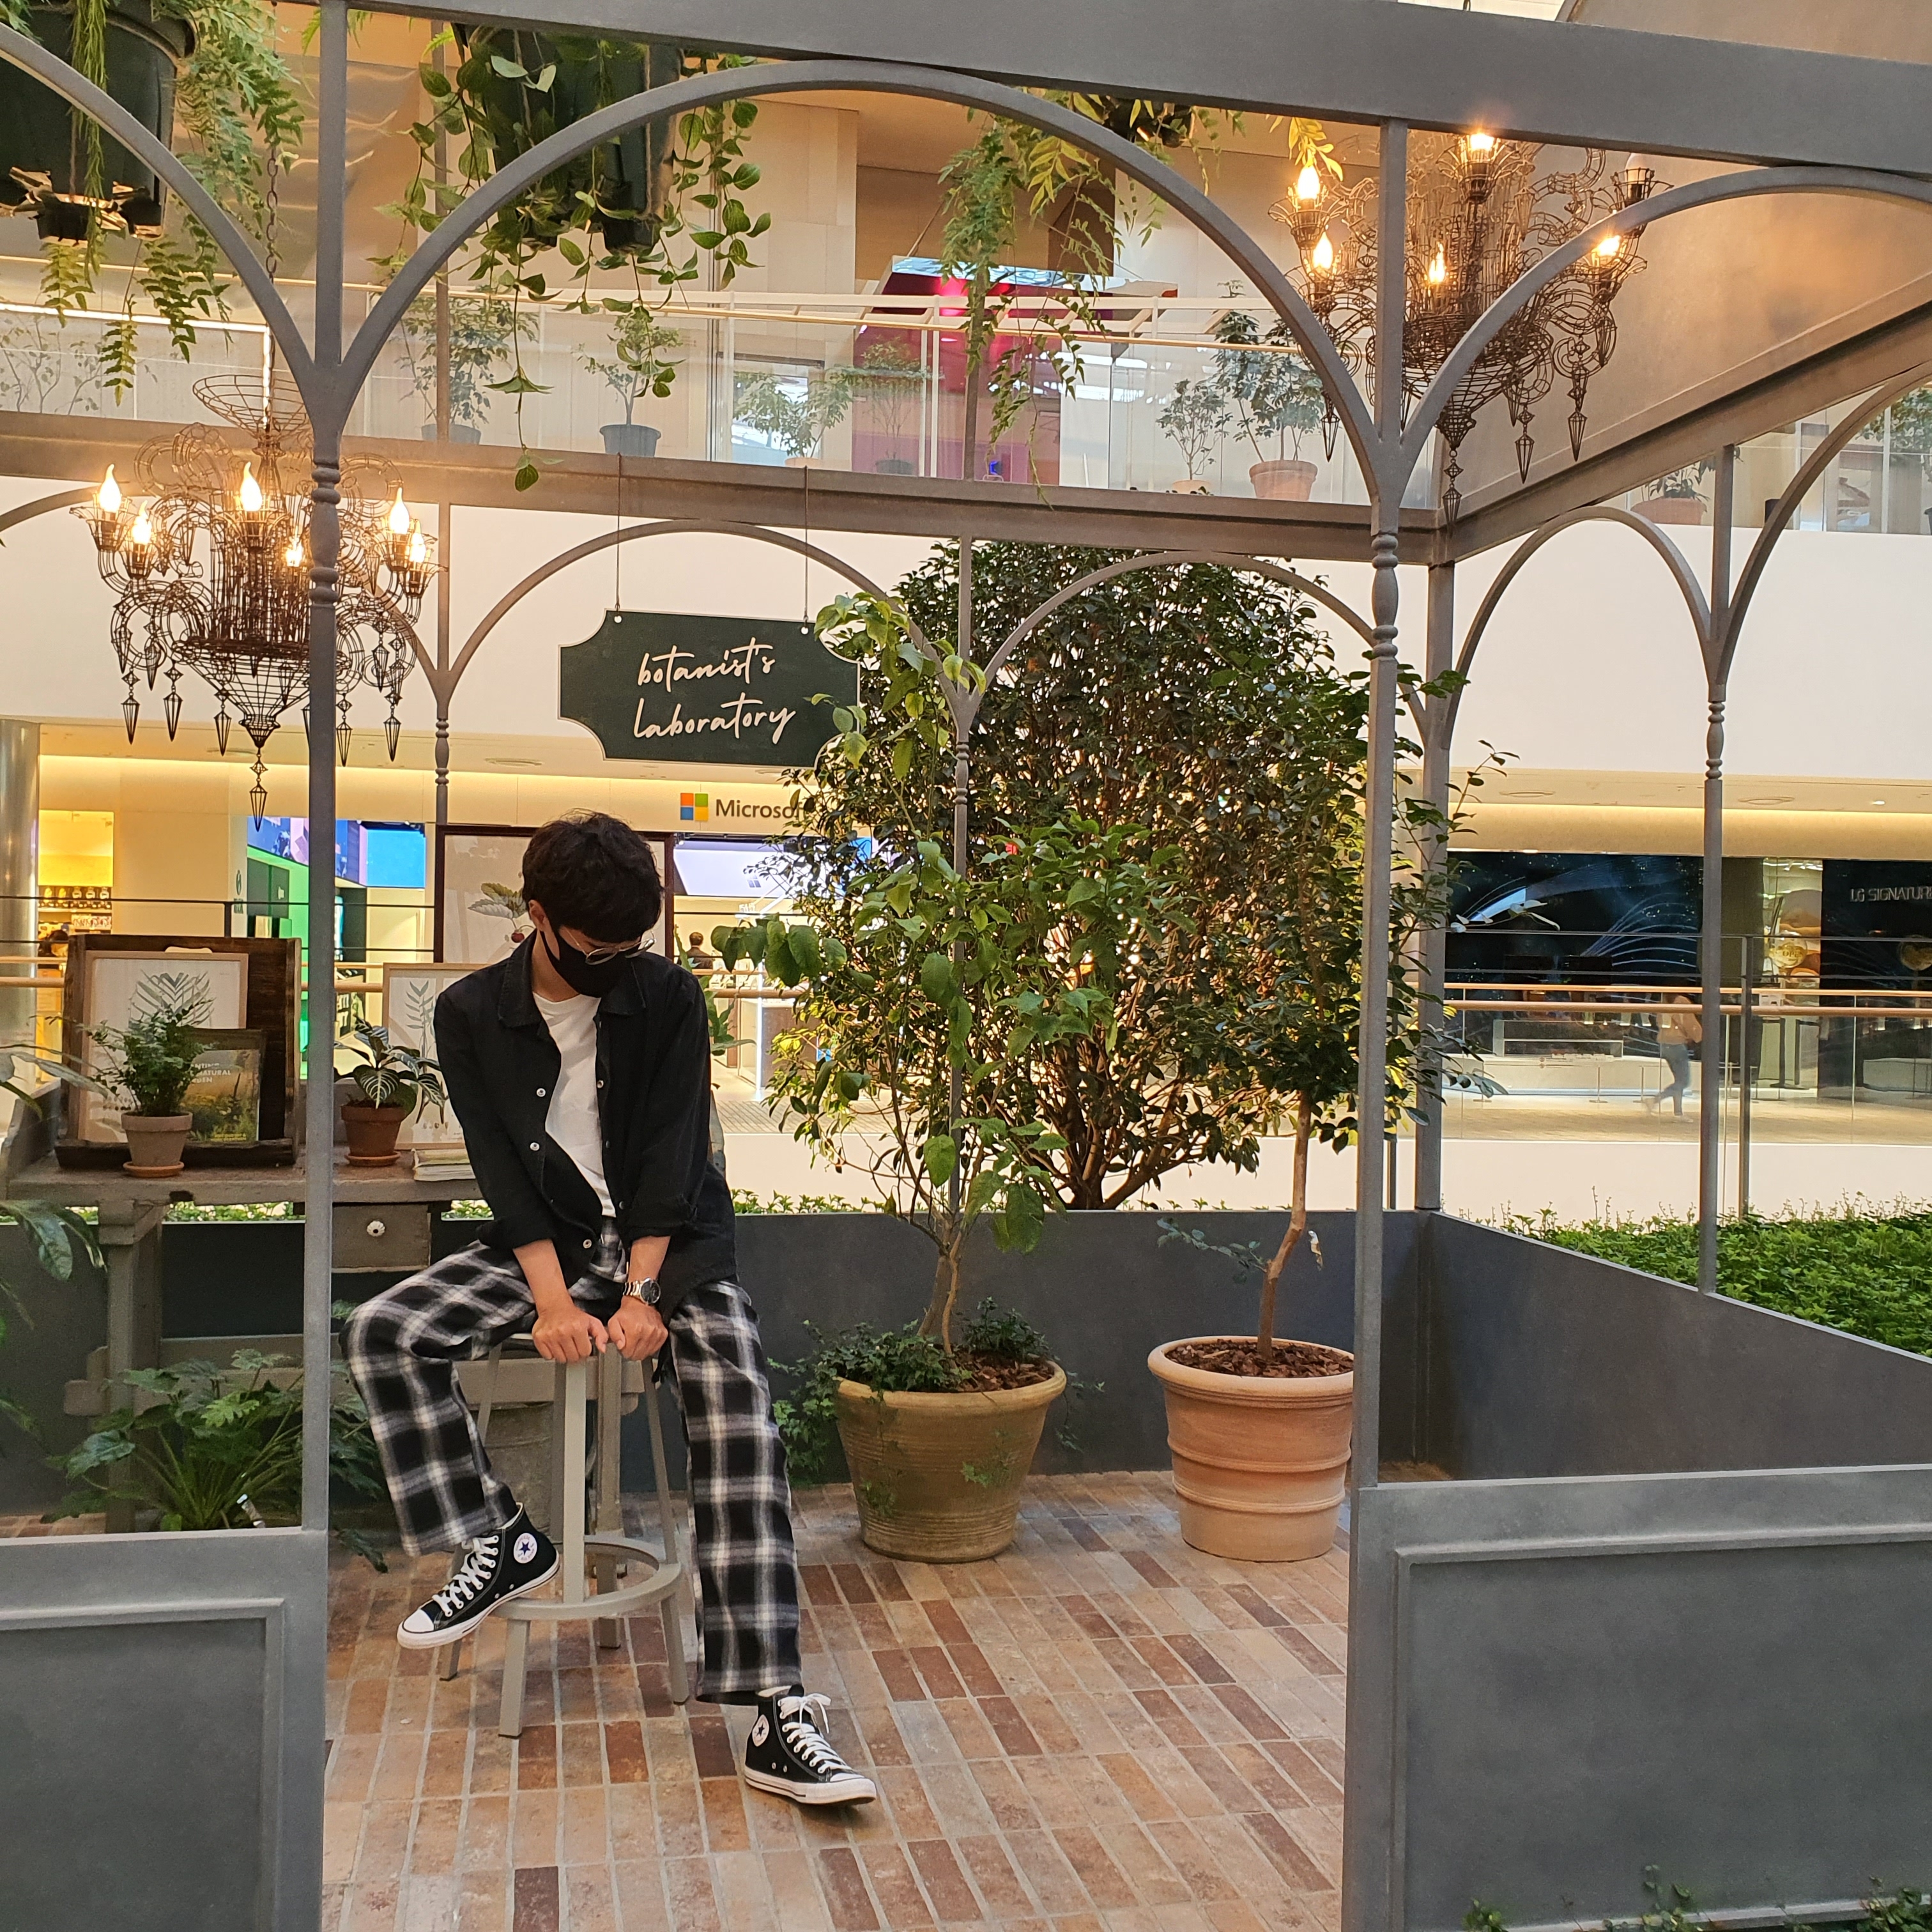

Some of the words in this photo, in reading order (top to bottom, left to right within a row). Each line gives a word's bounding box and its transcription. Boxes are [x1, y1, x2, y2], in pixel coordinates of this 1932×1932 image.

[638, 637, 775, 692] botanist's
[634, 692, 796, 744] laboratory
[716, 799, 805, 818] Microsof
[1850, 888, 1865, 902] LG
